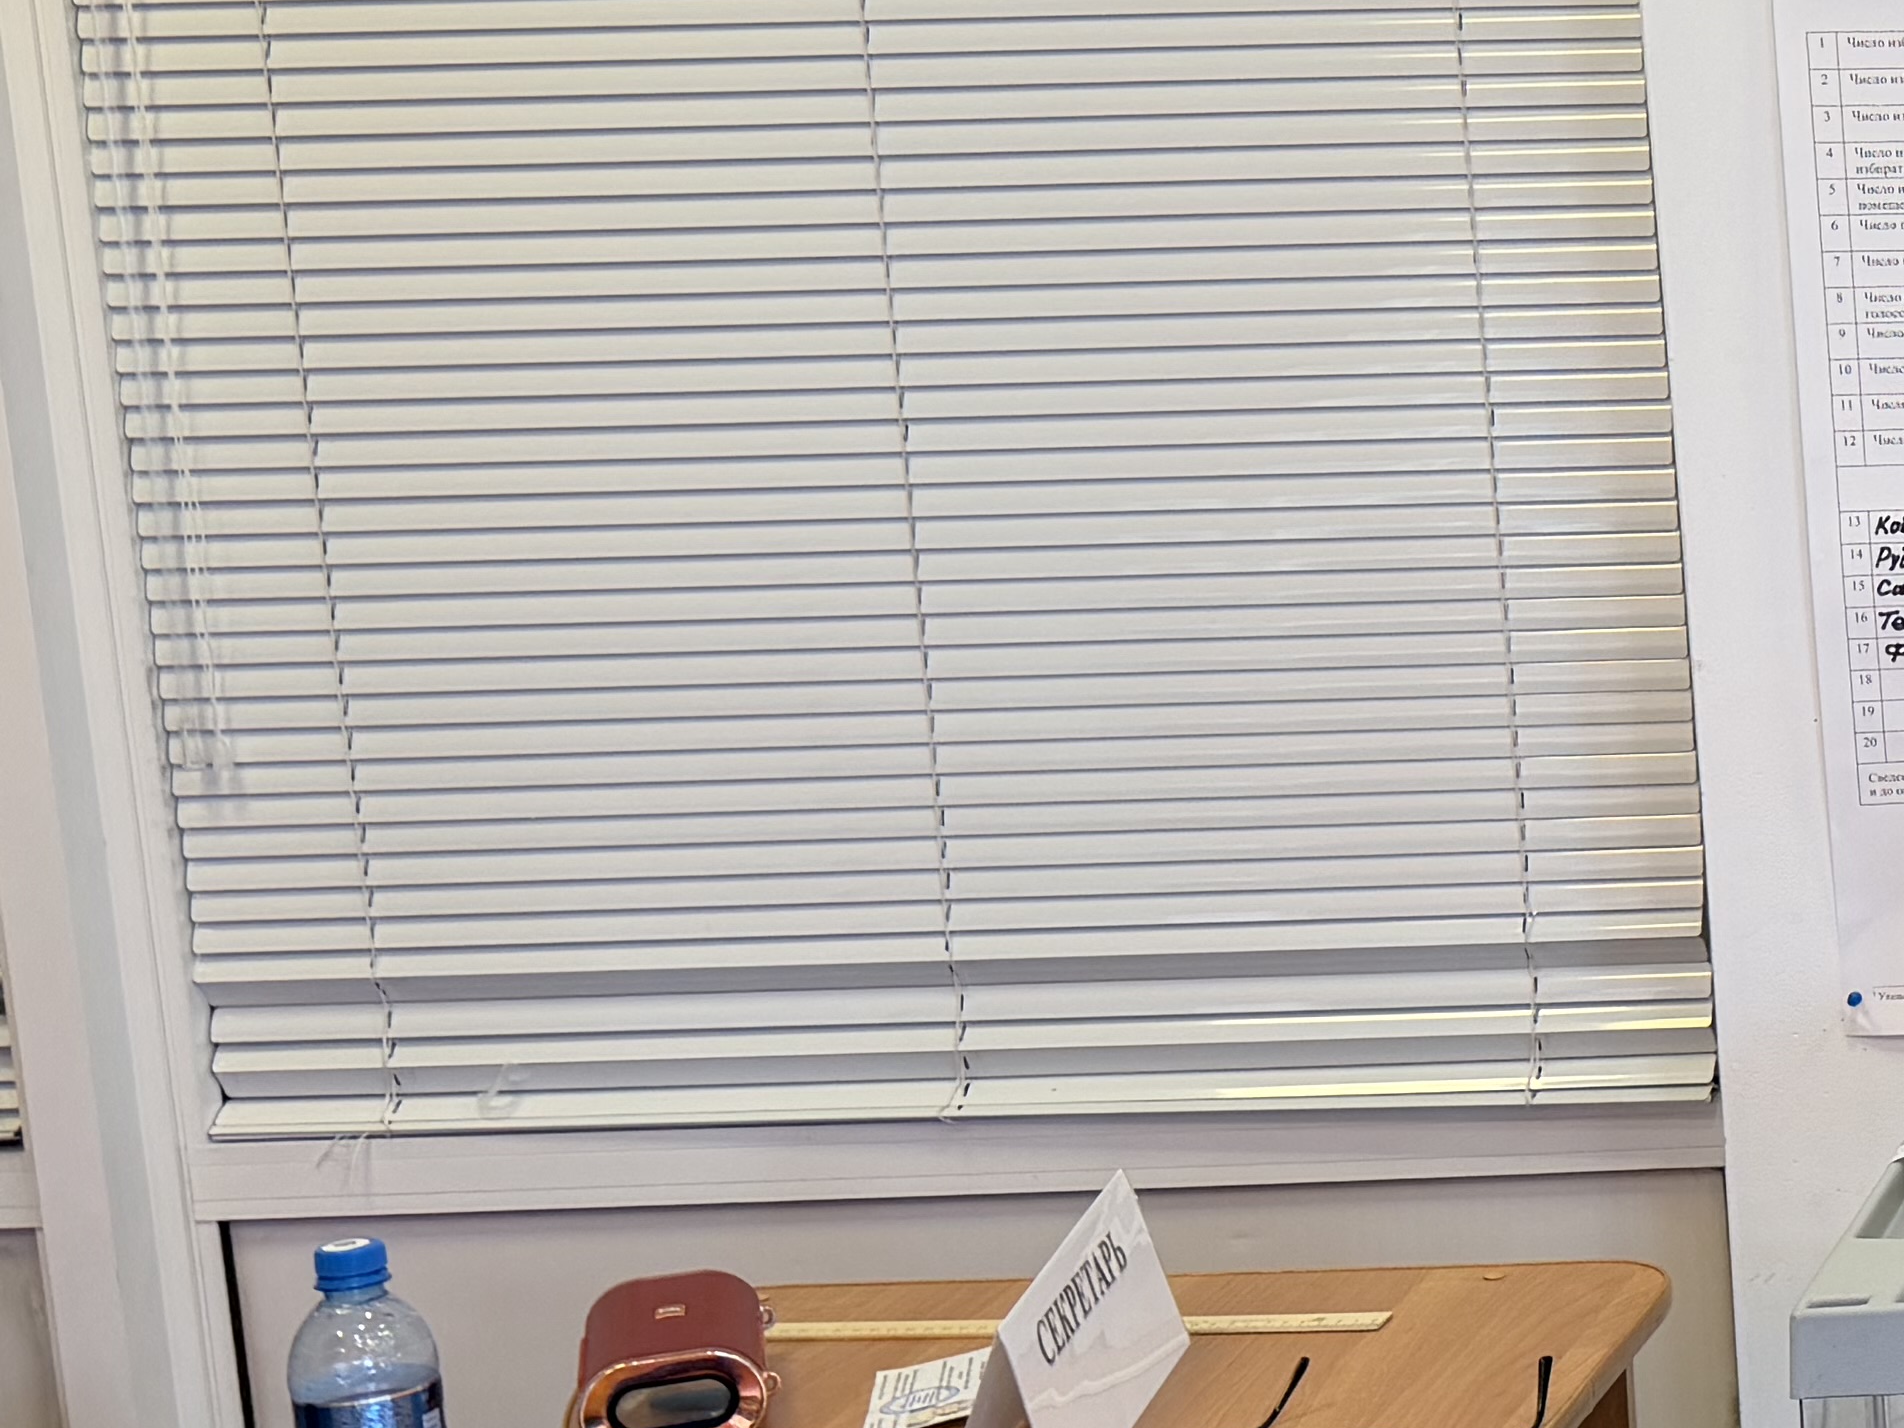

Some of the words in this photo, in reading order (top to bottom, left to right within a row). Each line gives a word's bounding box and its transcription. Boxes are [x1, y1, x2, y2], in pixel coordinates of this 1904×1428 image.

[1819, 38, 1825, 48] 1
[1821, 74, 1829, 85] 2
[1824, 111, 1831, 122] 3
[1826, 147, 1834, 158] 4
[1828, 184, 1836, 195] 5
[1831, 220, 1839, 231] 6
[1833, 256, 1841, 267] 7
[1836, 292, 1844, 303] 8
[1839, 329, 1846, 339] 9
[1838, 365, 1852, 375] 10
[1841, 400, 1853, 411] 11
[1843, 436, 1856, 447] 12
[1848, 515, 1861, 527] 13
[1850, 549, 1863, 560] 14
[1852, 580, 1865, 592] 15
[1854, 612, 1868, 623] 16
[1857, 643, 1870, 654] 17
[1858, 674, 1873, 685] 18
[1860, 705, 1876, 717] 19
[1862, 736, 1877, 748] 20
[1037, 1231, 1127, 1366] СЕКРЕТАРЬ
